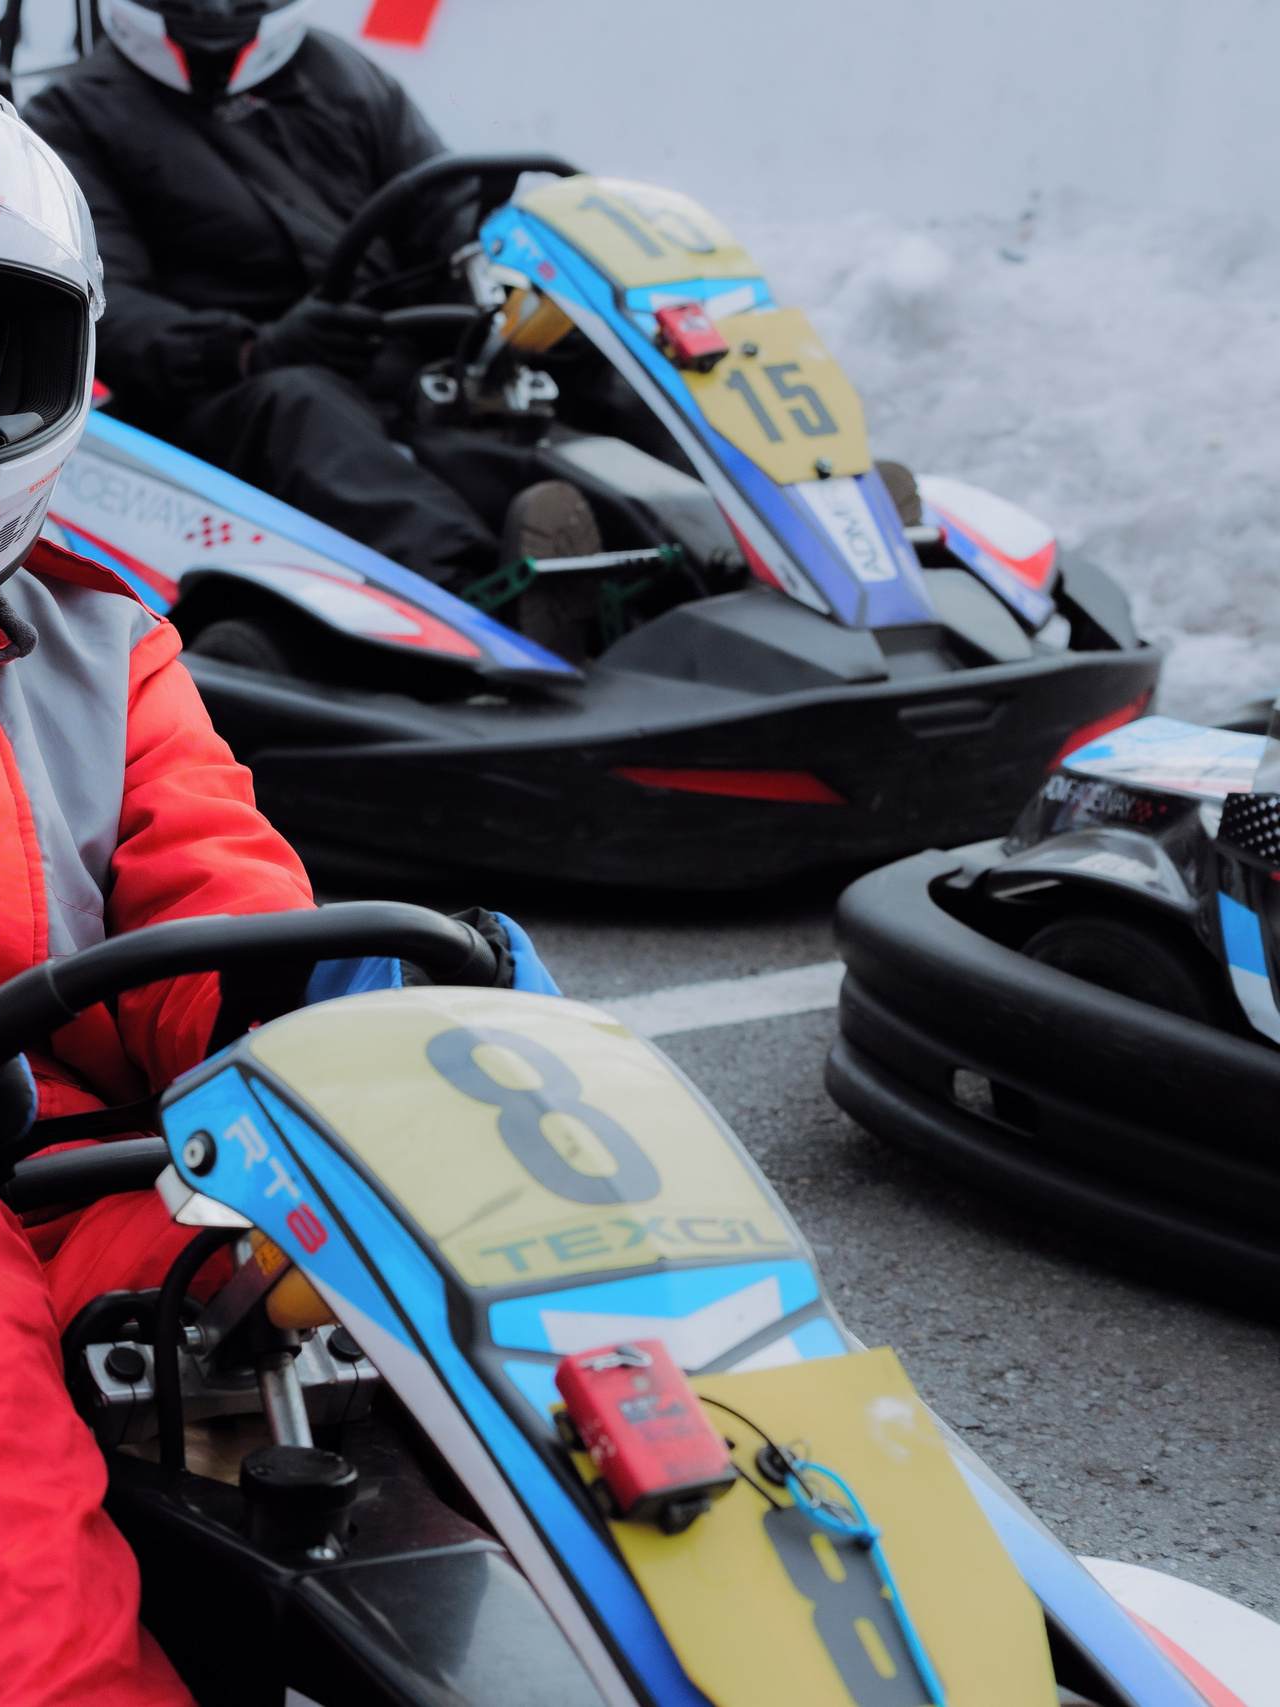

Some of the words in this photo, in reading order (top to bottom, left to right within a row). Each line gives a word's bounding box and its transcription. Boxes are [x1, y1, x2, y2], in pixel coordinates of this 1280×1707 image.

[725, 364, 839, 442] 15
[223, 1114, 329, 1255] RT8
[426, 1026, 662, 1206] 8
[762, 1502, 942, 1706] 8
